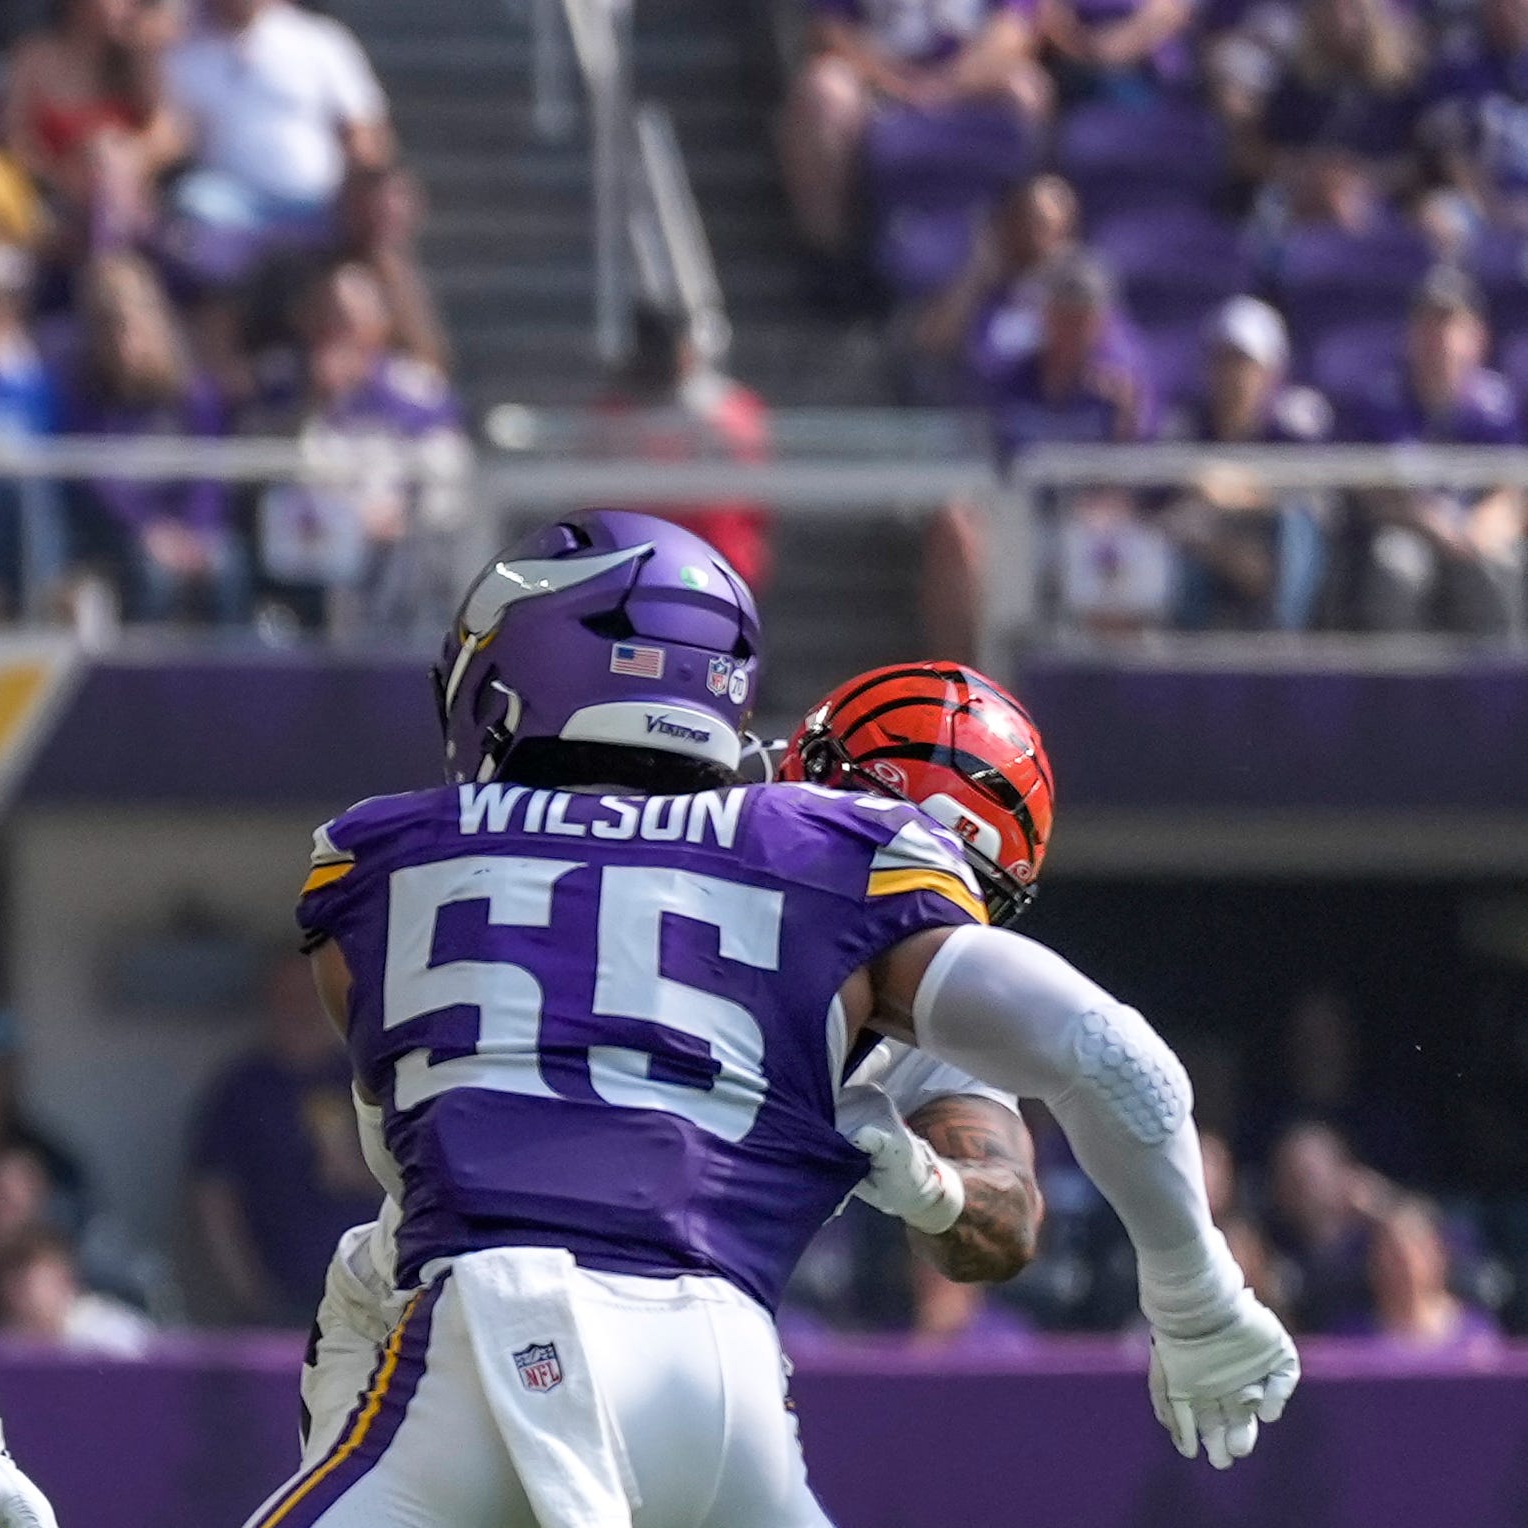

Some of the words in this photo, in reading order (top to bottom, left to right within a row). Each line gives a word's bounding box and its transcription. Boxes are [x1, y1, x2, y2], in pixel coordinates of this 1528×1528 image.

[458, 782, 747, 849] WILSON
[382, 855, 784, 1143] 55
[524, 1360, 560, 1389] NFL
